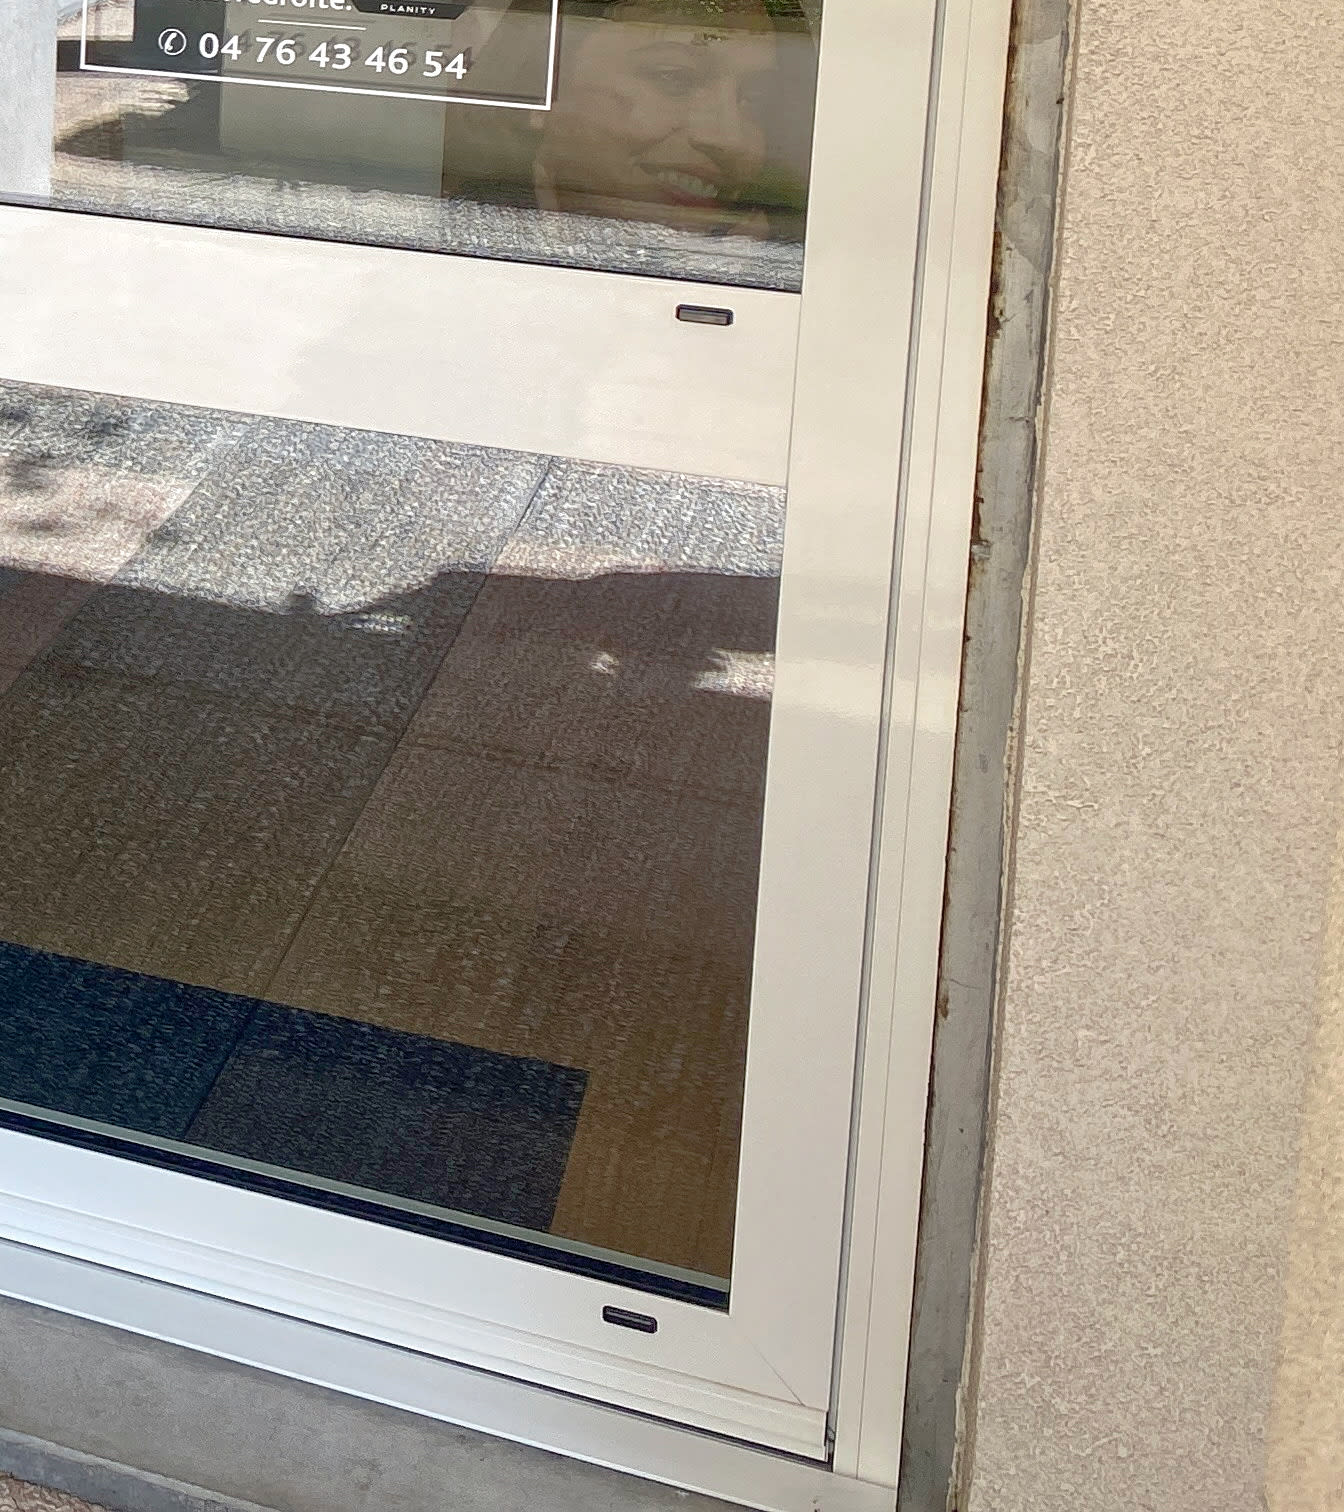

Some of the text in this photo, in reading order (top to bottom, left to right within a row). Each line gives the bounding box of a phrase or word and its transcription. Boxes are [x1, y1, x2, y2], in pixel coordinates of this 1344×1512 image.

[380, 2, 437, 16] PLANITY
[198, 32, 468, 80] 04 76 43 46 54
